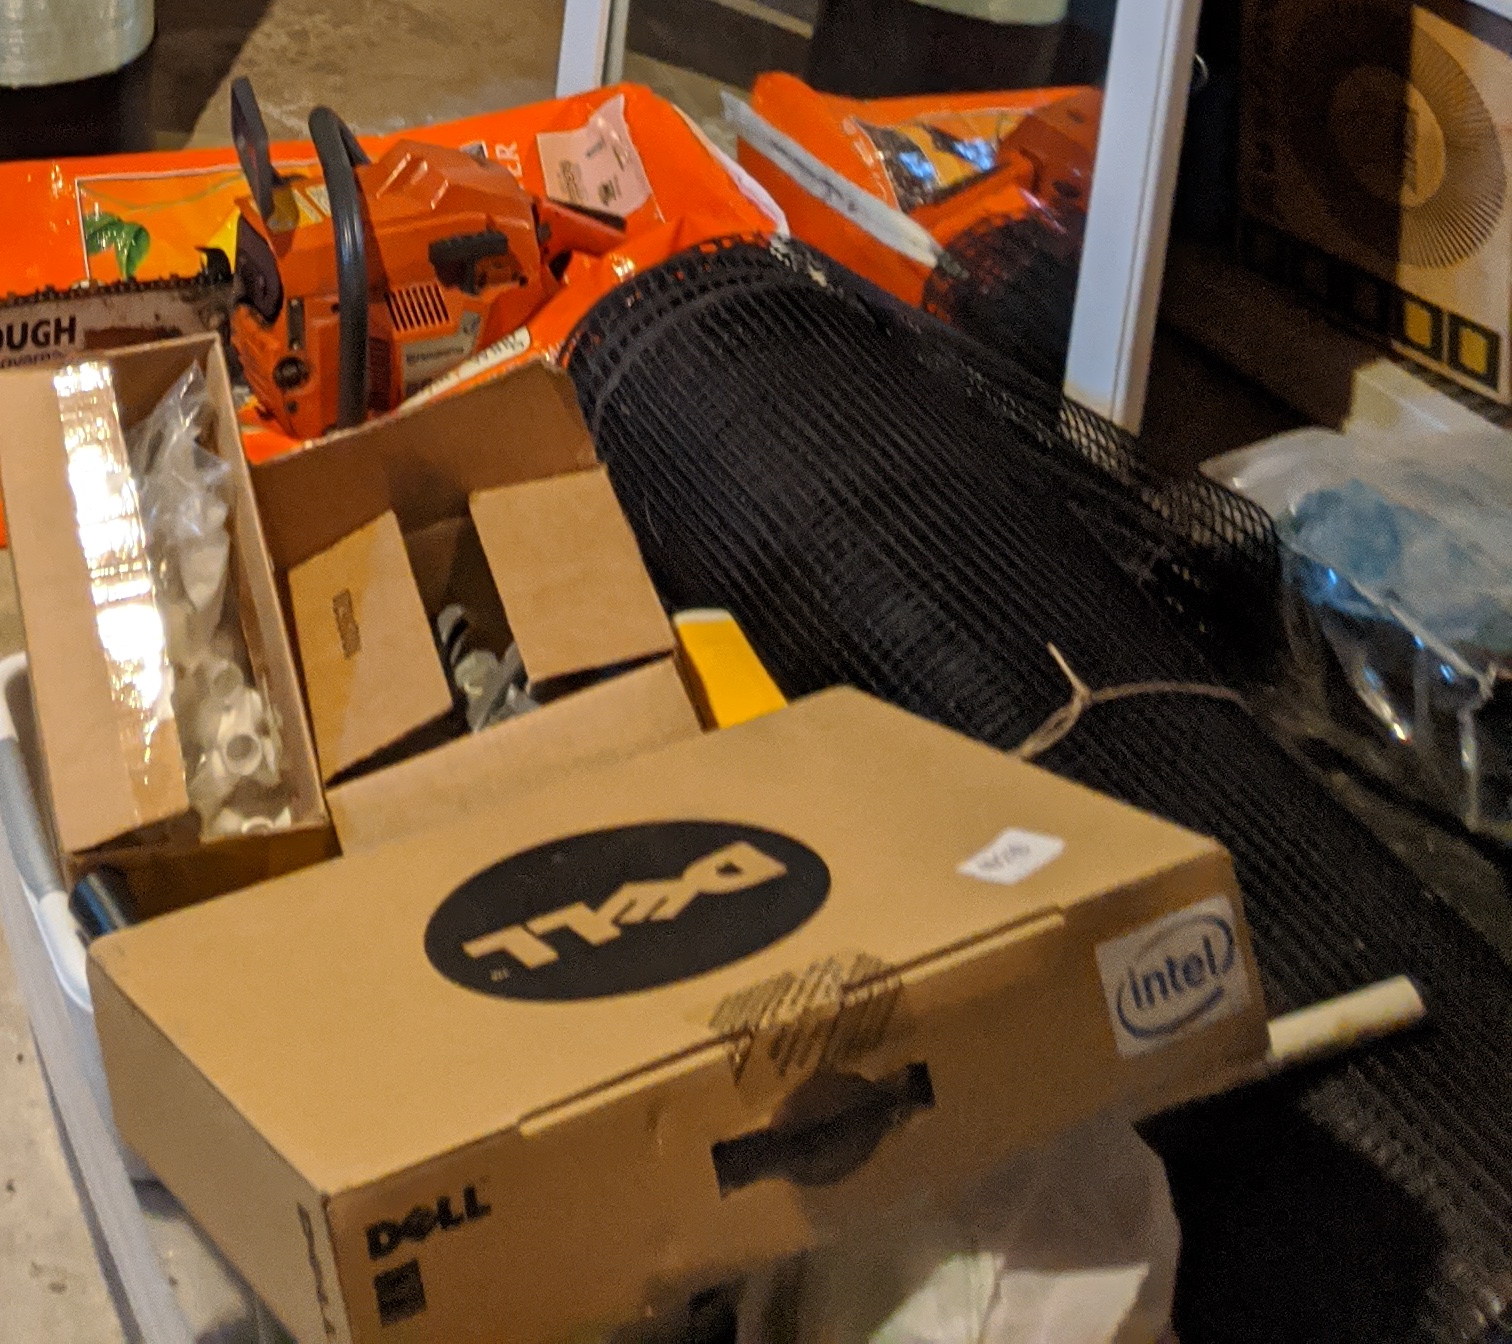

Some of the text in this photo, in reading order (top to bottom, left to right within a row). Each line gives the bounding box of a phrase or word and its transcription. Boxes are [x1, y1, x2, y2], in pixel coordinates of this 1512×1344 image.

[462, 840, 787, 970] DELL
[1127, 934, 1218, 1011] intel
[365, 1184, 492, 1262] DELL
